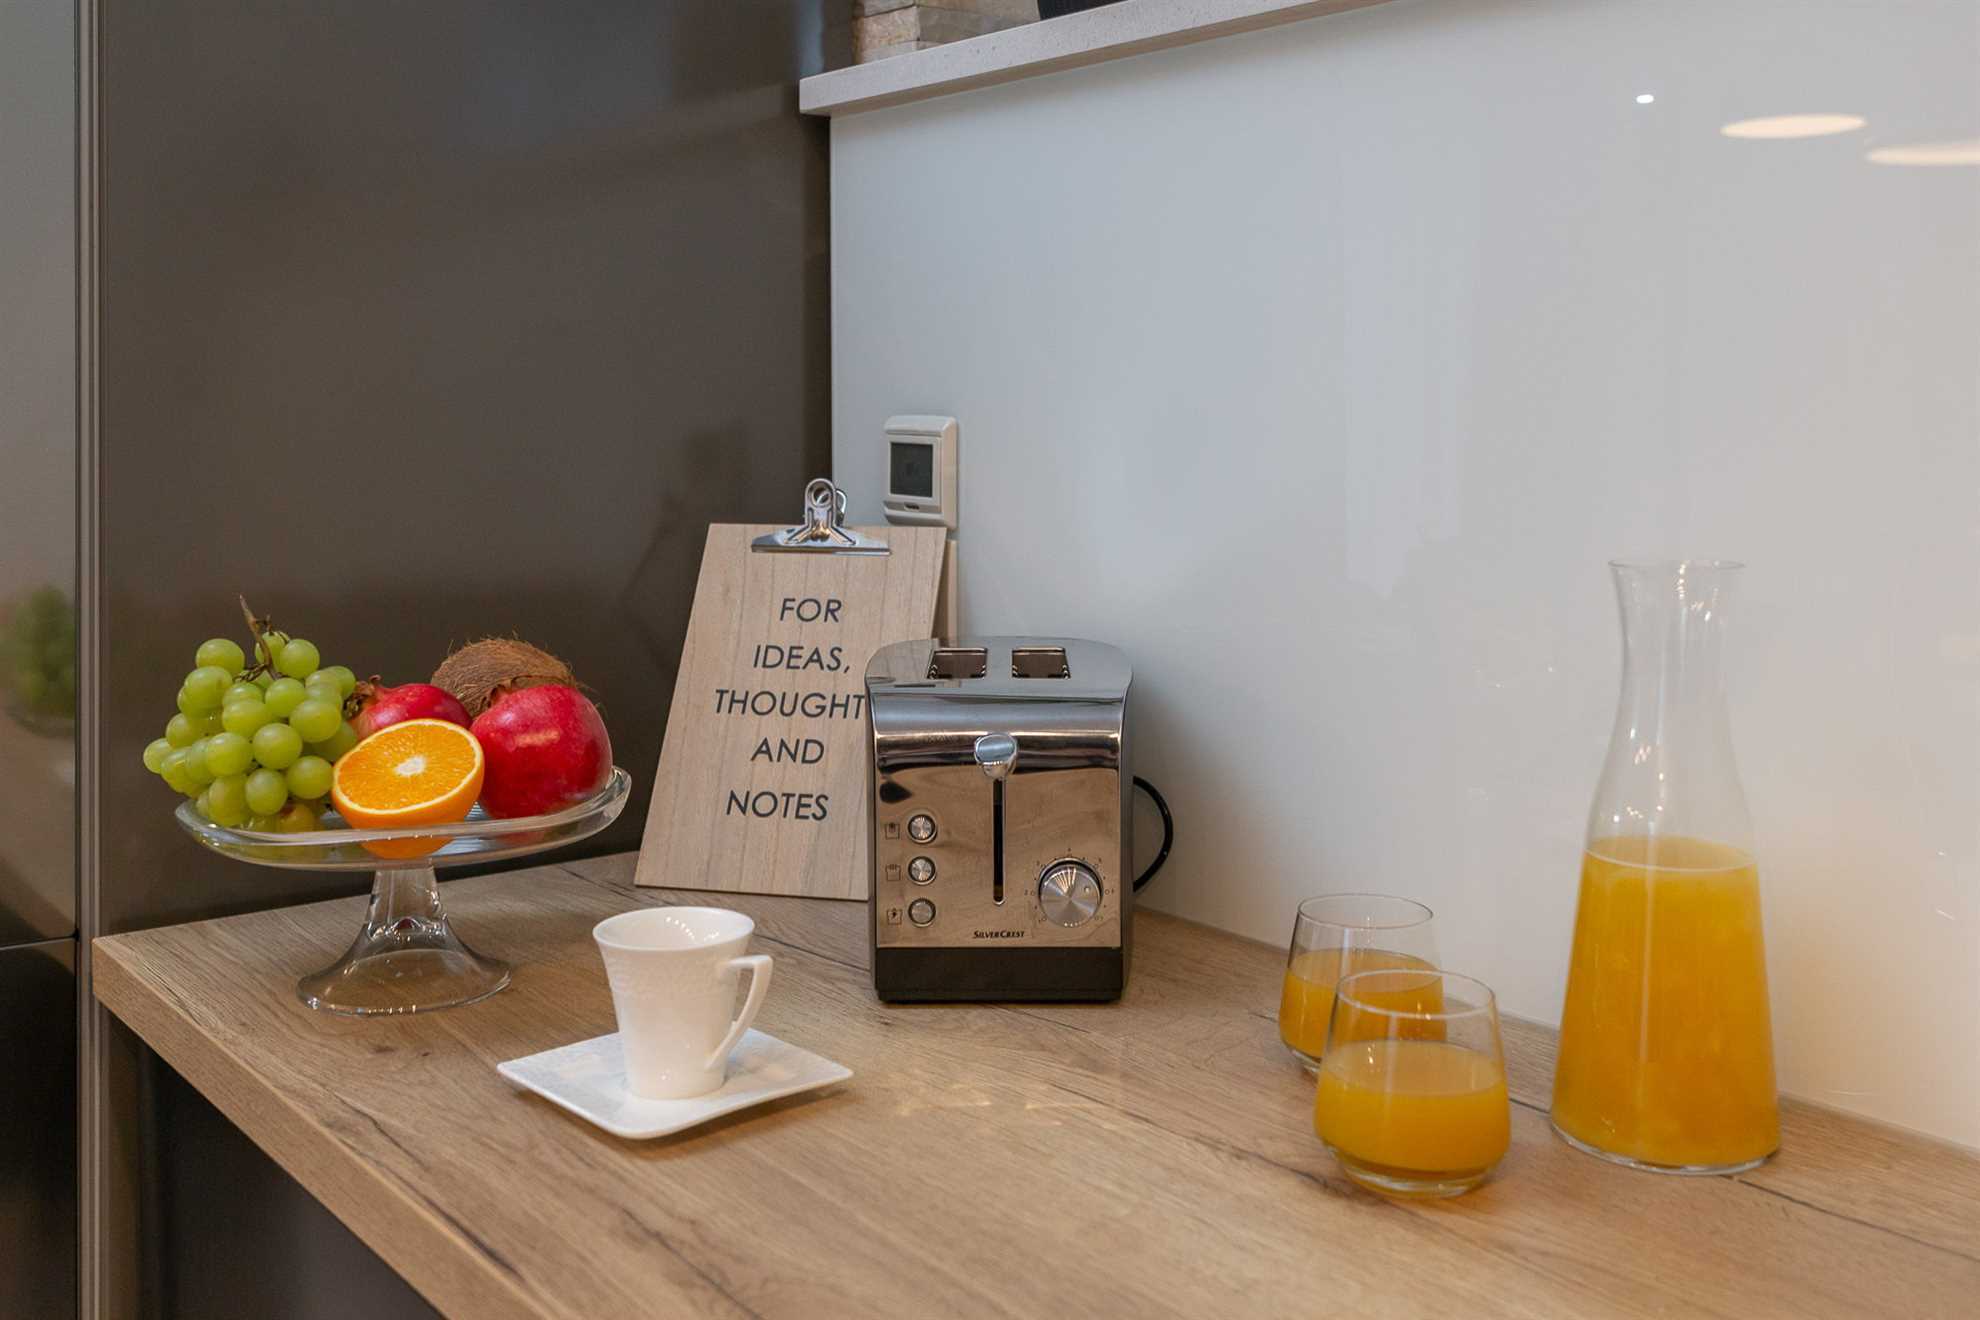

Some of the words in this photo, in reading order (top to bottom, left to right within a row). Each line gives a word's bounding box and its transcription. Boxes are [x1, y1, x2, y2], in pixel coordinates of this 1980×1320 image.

[779, 597, 842, 623] FOR
[752, 644, 850, 673] IDEAS,
[750, 737, 825, 764] AND
[726, 789, 829, 821] NOTES
